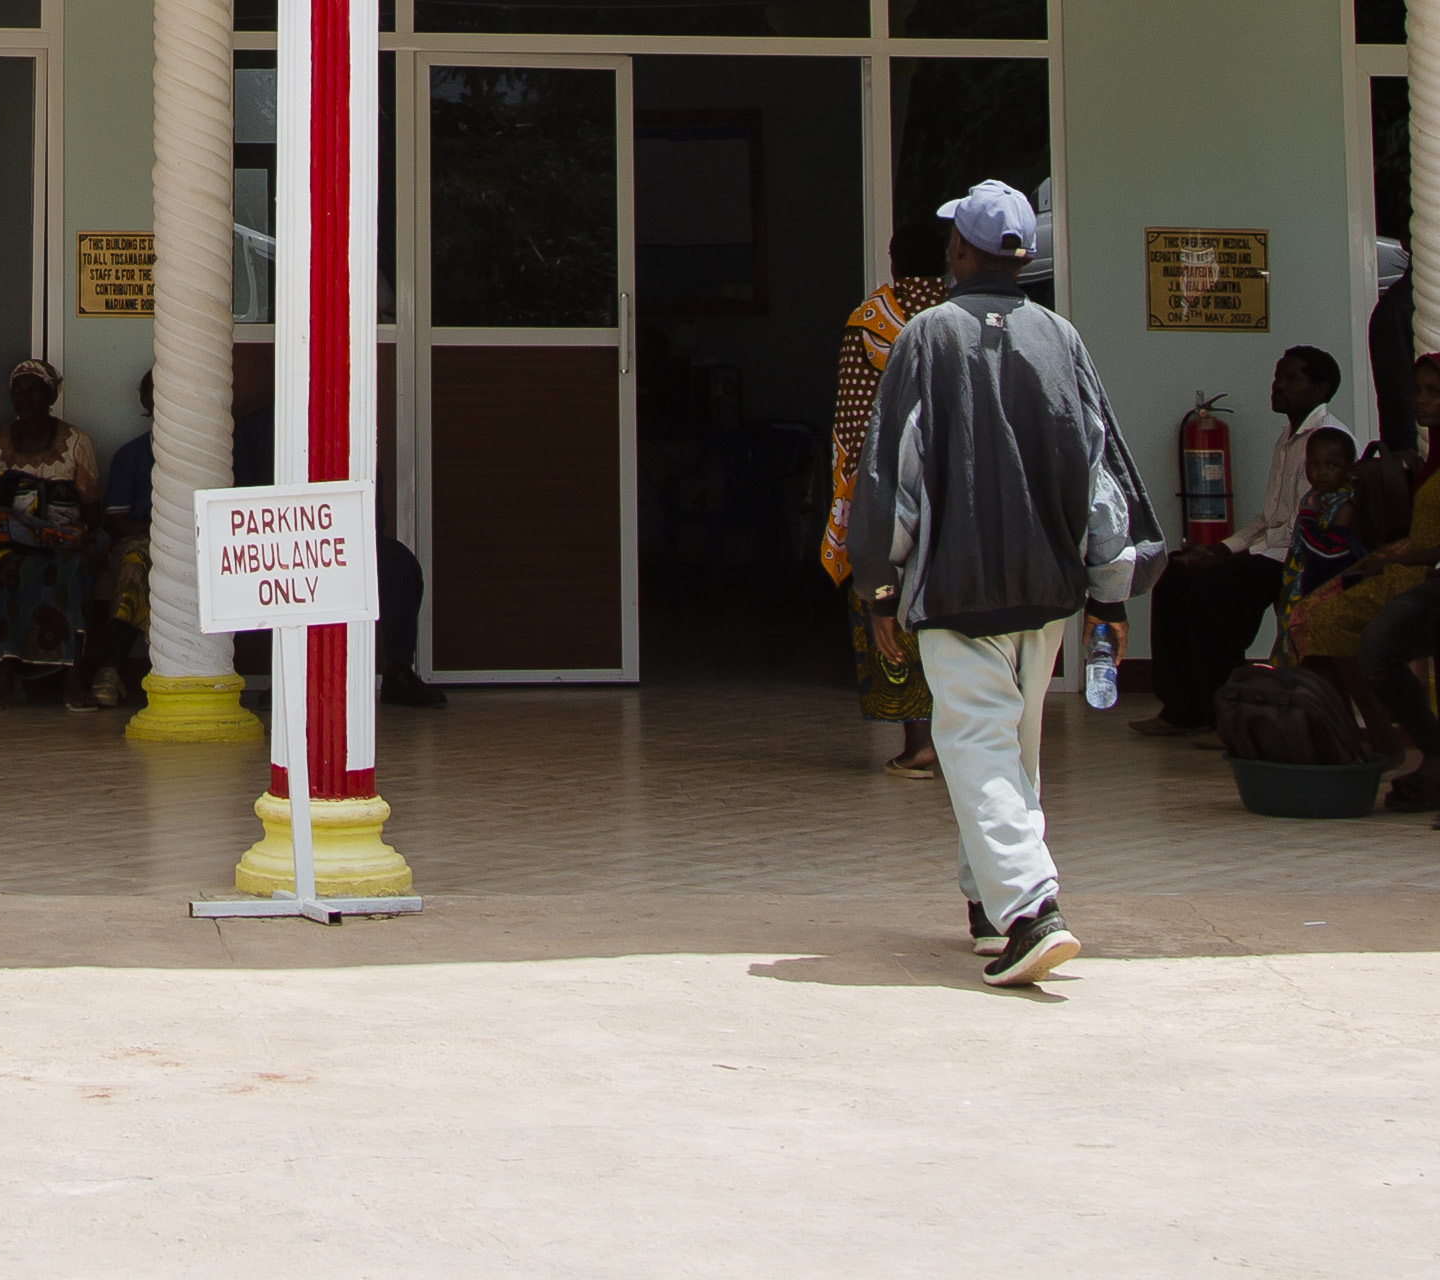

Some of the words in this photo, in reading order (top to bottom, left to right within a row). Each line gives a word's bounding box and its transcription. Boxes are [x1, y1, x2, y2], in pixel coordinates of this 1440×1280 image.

[88, 238, 104, 250] THIS
[105, 238, 138, 250] BUILDING
[139, 238, 146, 250] IS
[1163, 236, 1180, 249] THIS
[83, 252, 92, 265] TO
[93, 252, 107, 265] ALL
[110, 252, 157, 265] TOSAMAGANG
[1211, 251, 1238, 264] LESSED
[89, 268, 112, 281] STAFF
[114, 268, 120, 280] &
[121, 268, 136, 281] FOR
[138, 268, 152, 281] THE
[95, 283, 143, 296] CONTRIBUTION
[1168, 294, 1200, 310] (BIHOP
[1201, 295, 1212, 310] OF
[1167, 311, 1182, 323] ON
[1229, 312, 1252, 324] 2023
[230, 503, 333, 537] PARKING
[220, 537, 348, 576] AMBULANCE
[258, 575, 319, 606] ONLY
